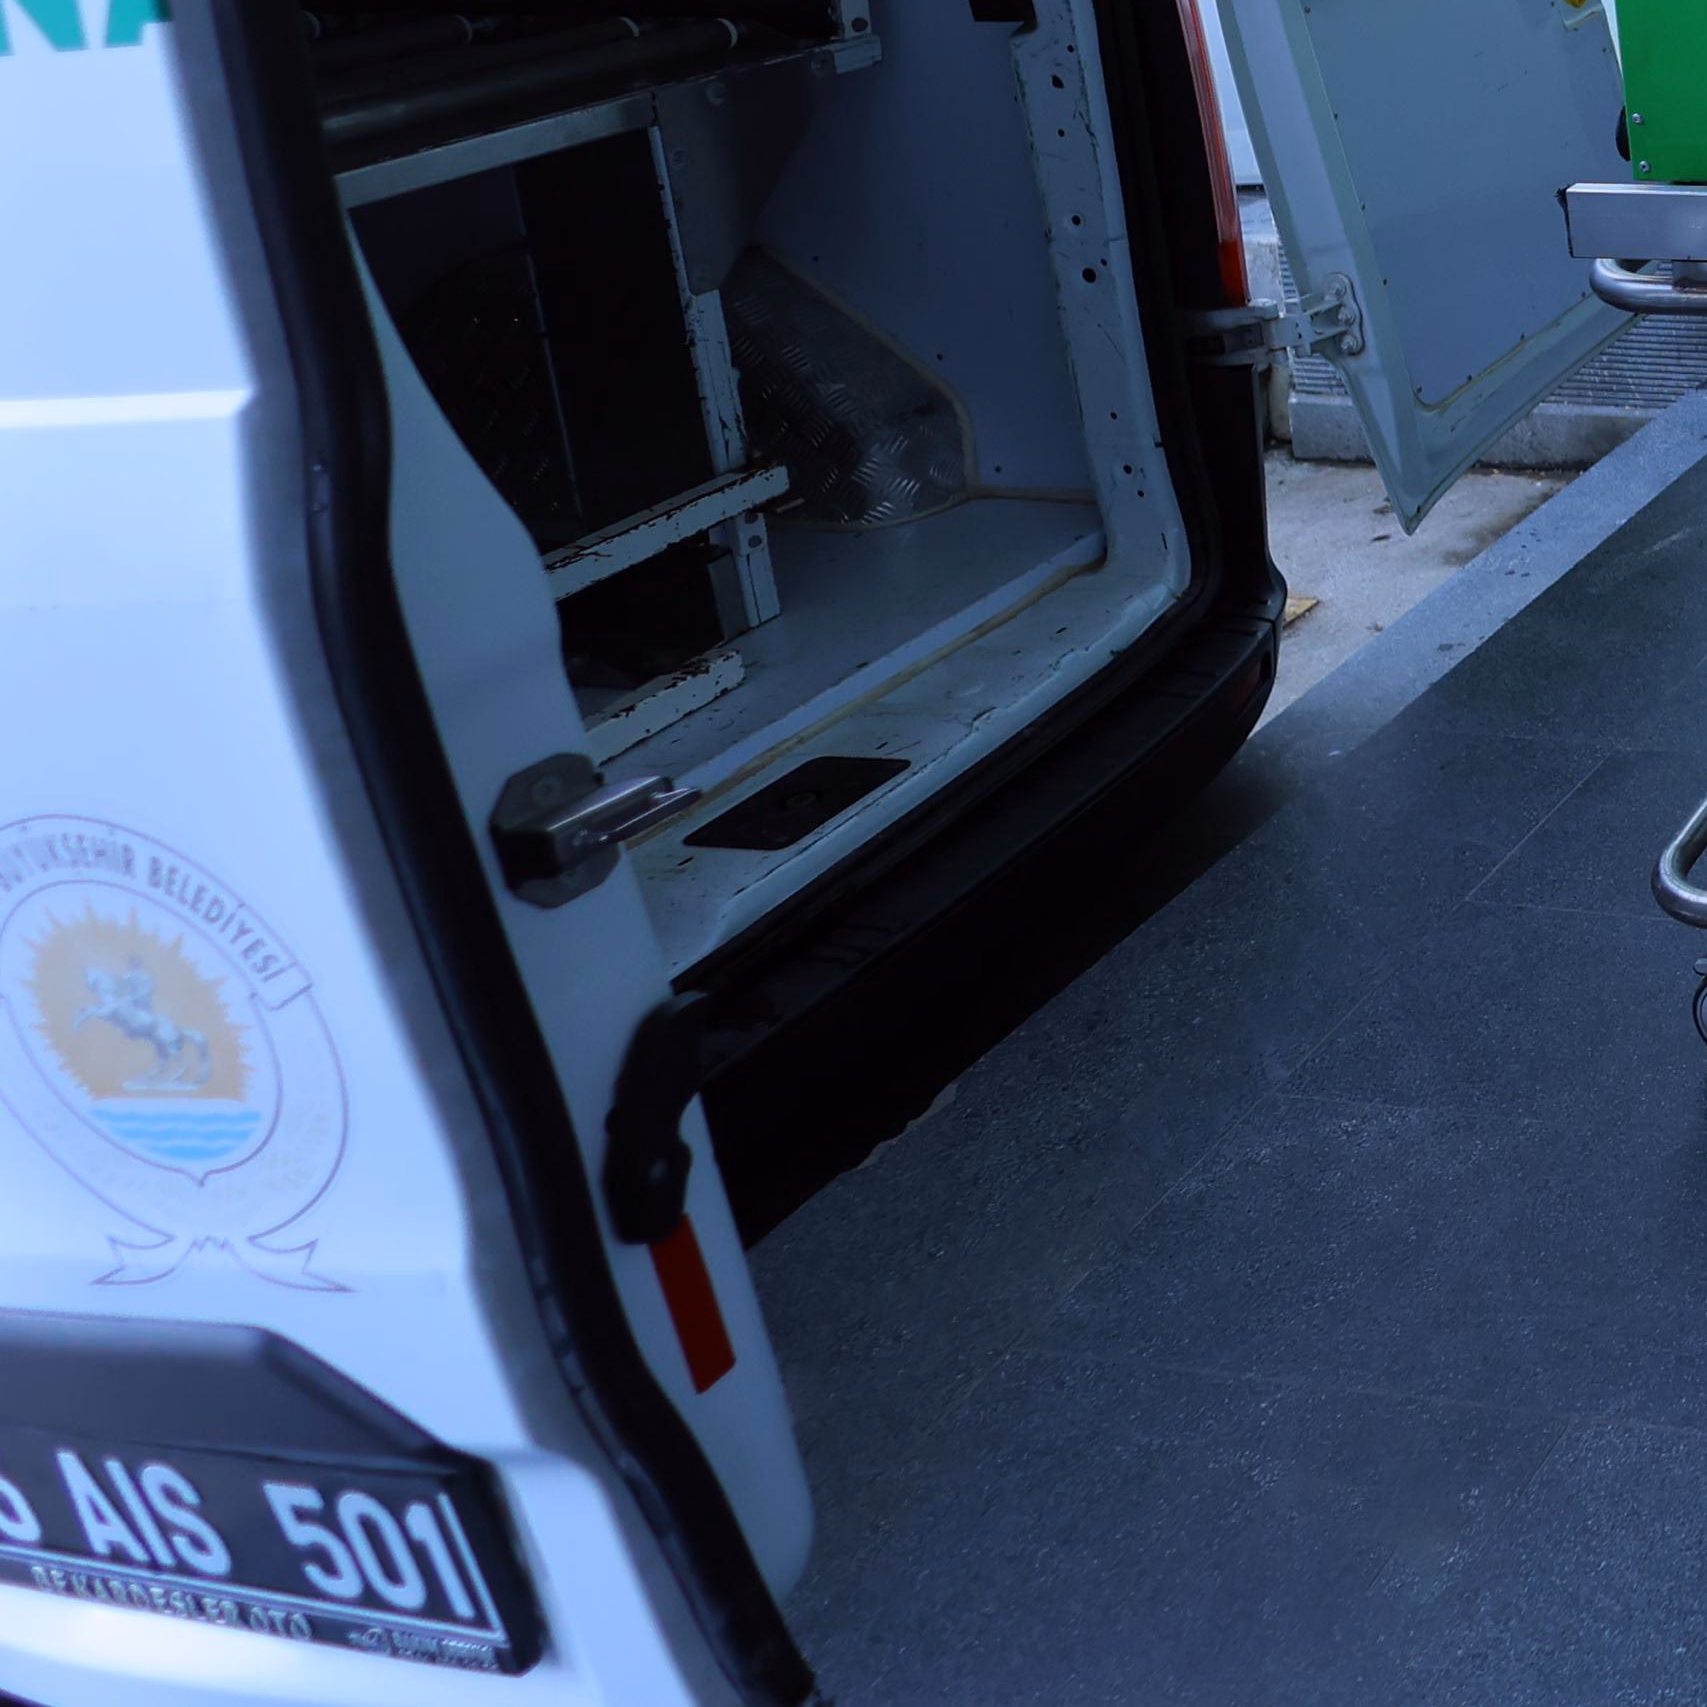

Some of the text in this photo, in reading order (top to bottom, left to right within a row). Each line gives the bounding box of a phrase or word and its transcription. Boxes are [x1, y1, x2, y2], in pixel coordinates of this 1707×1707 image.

[148, 855, 298, 982] BELEDİYESİ
[56, 1449, 232, 1578] AIS
[263, 1482, 476, 1619] 501
